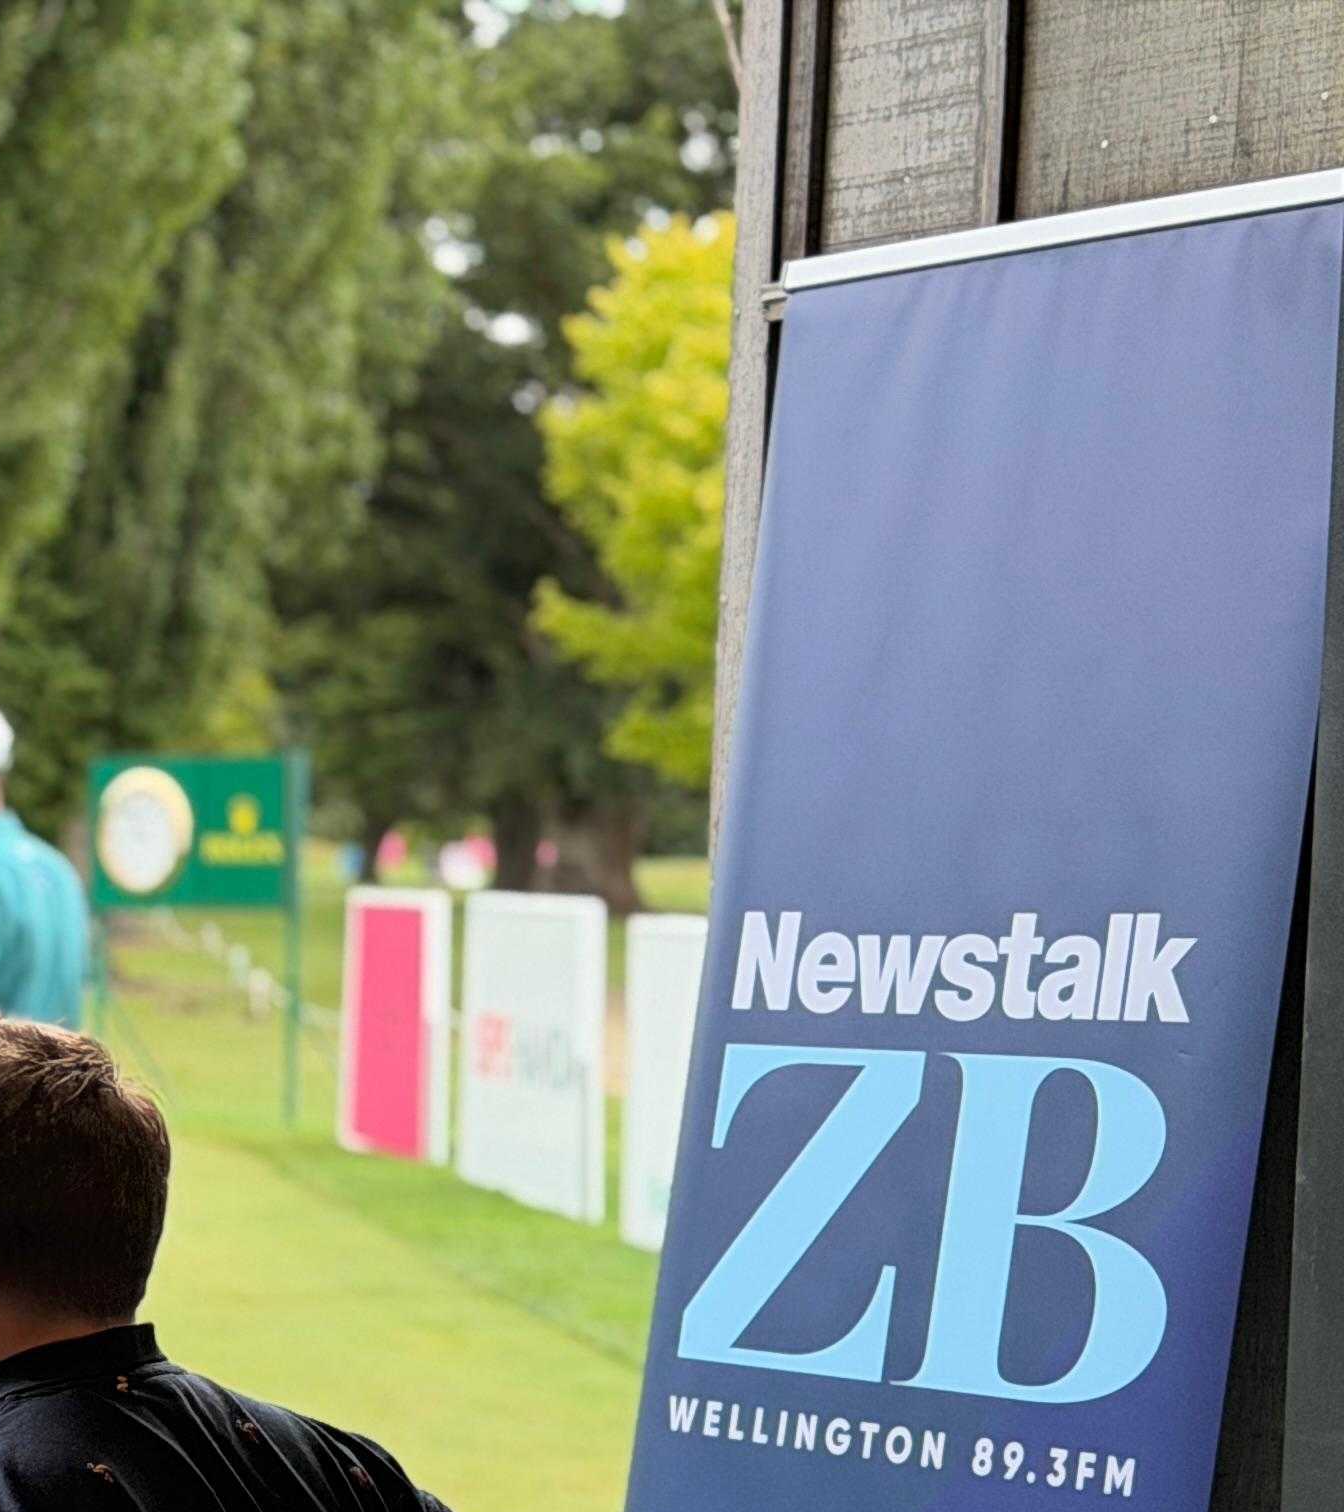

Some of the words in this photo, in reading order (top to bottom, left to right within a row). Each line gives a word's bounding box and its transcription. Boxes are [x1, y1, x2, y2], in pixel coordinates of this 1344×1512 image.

[731, 910, 1198, 1023] Newstalk
[677, 1042, 1168, 1404] ZB
[667, 1395, 947, 1471] WELLINGTON
[971, 1435, 1138, 1498] 89.3FM
